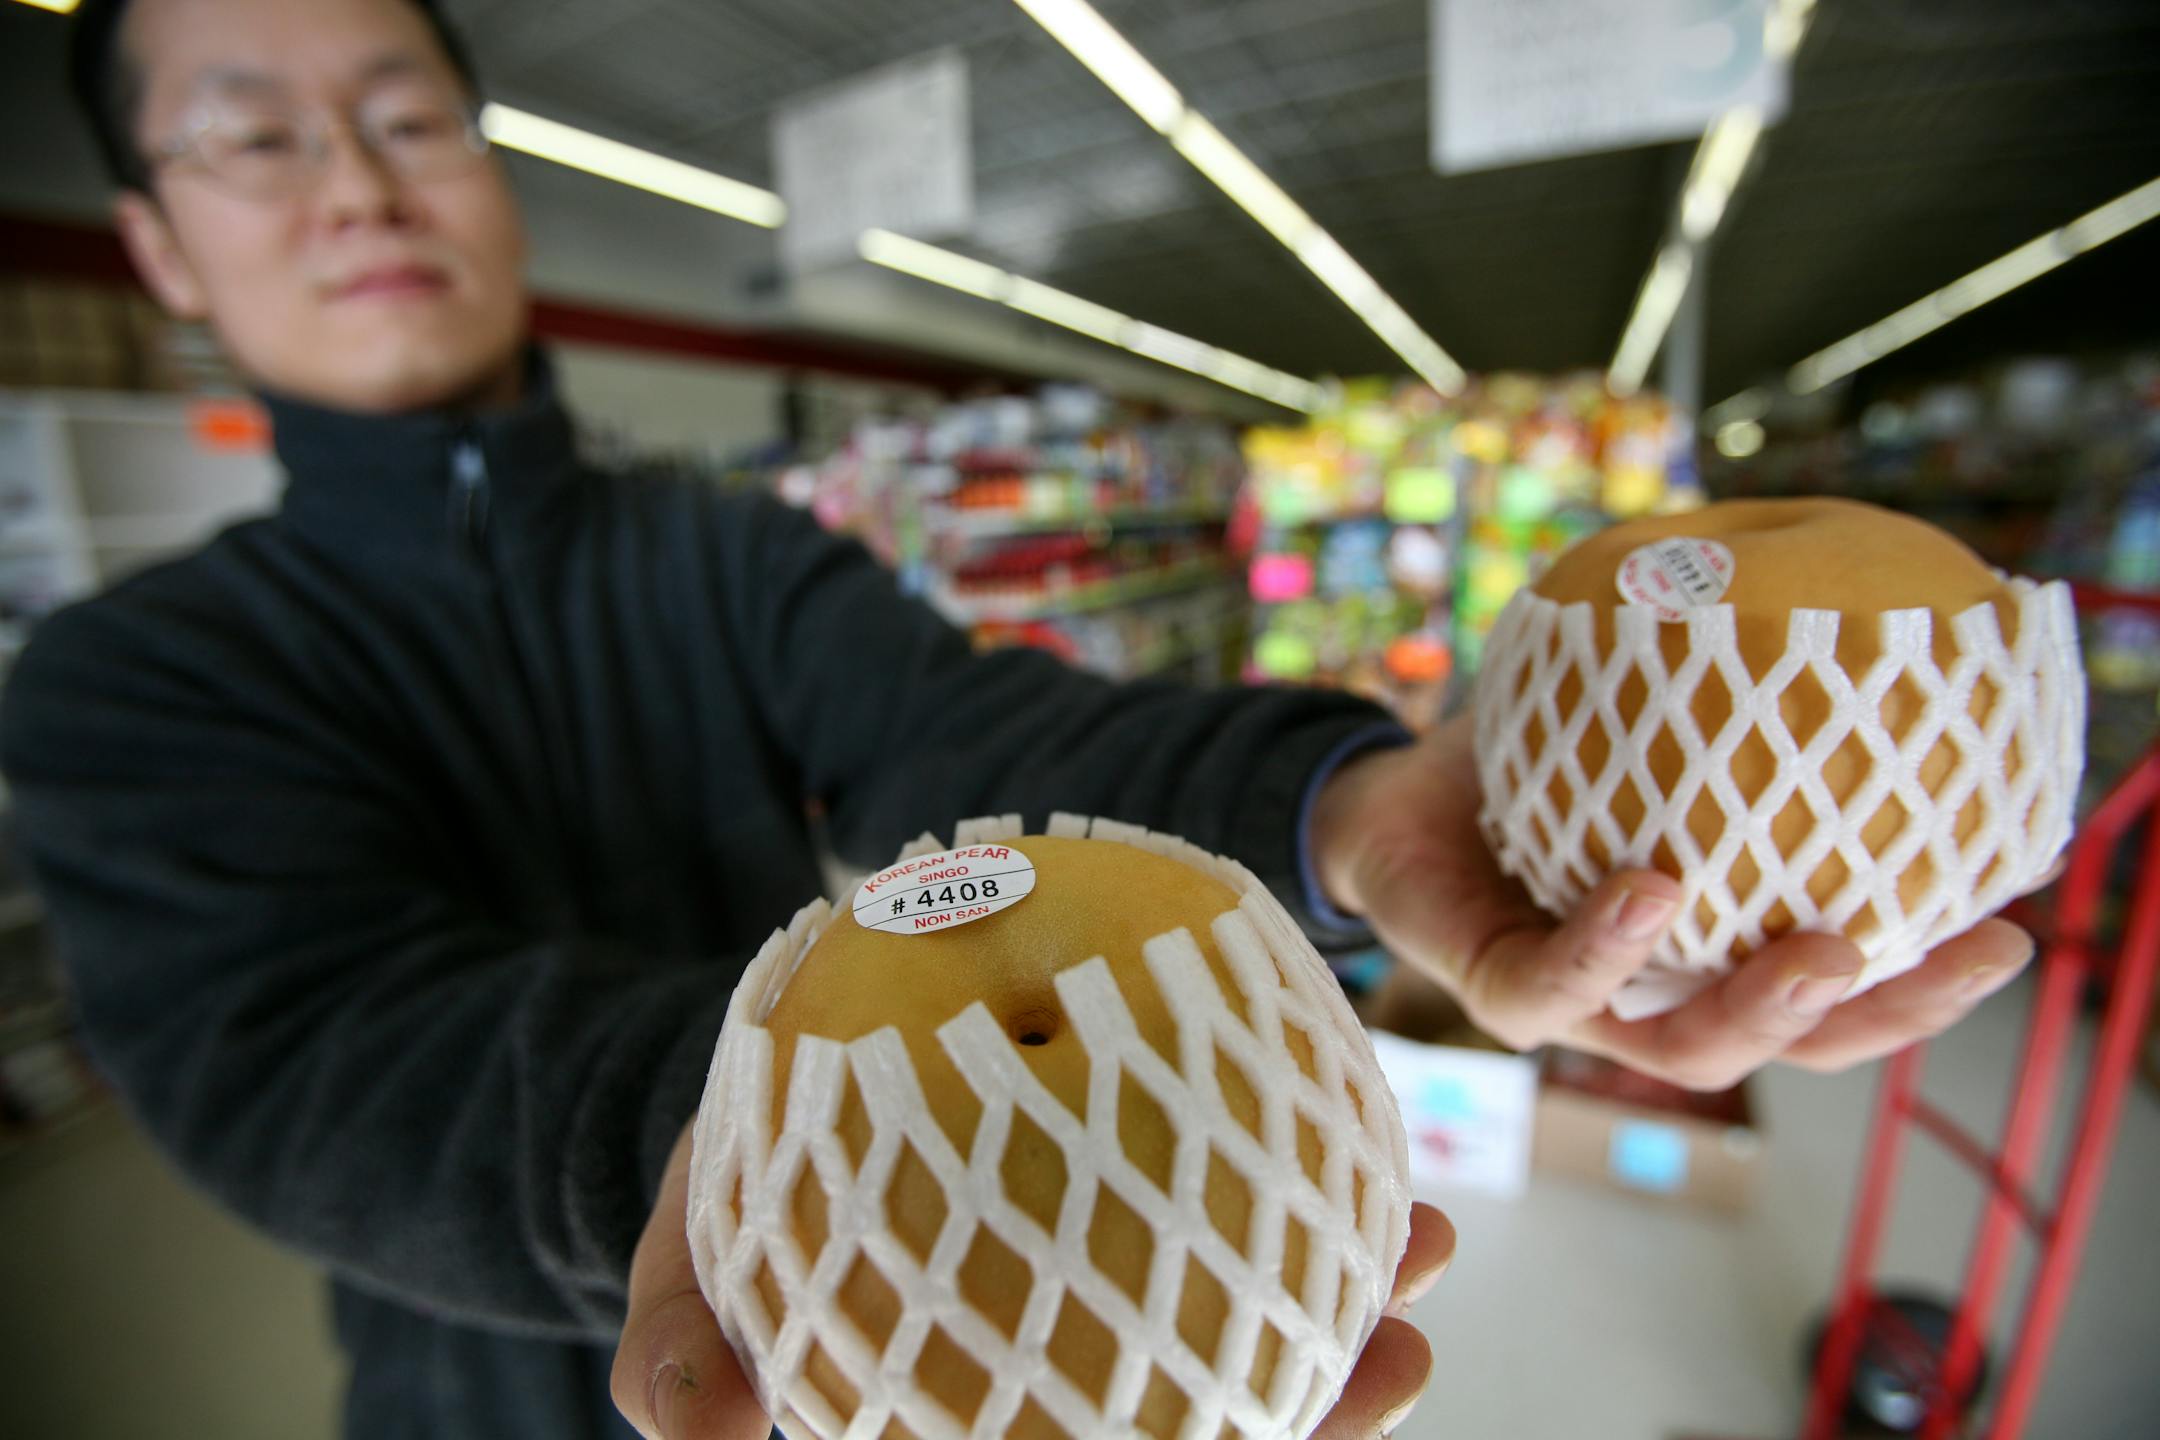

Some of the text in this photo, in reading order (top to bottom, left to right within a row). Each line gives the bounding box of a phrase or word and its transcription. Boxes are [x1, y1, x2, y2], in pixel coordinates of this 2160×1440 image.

[865, 847, 1009, 892] KOREAN PEAR
[919, 866, 968, 883] SINGO
[891, 880, 999, 914] # 4408
[914, 906, 990, 928] NON SAN
